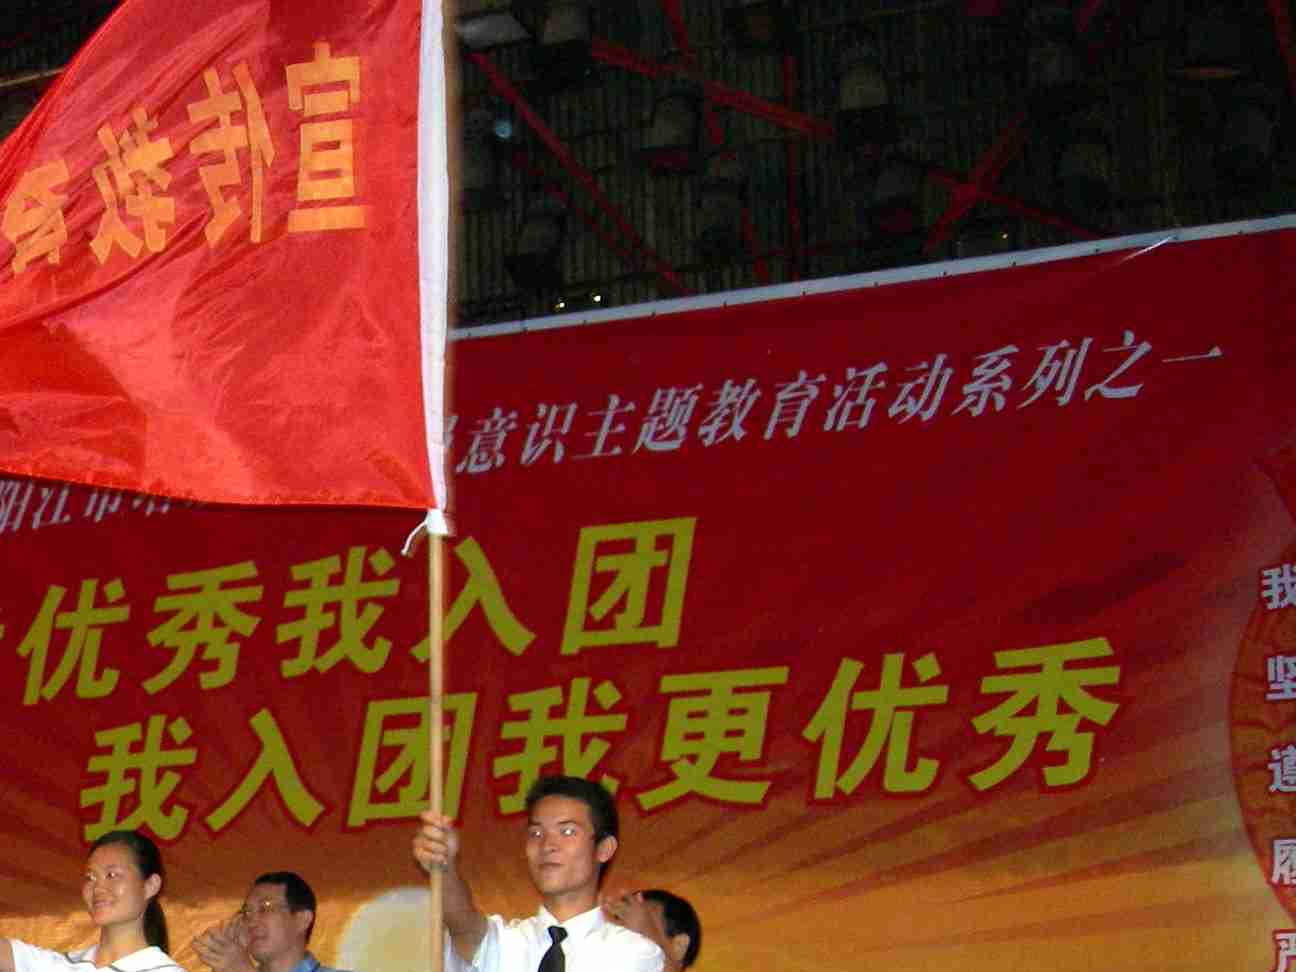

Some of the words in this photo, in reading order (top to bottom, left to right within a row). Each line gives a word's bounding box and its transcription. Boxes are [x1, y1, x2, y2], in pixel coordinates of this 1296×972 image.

[80, 636, 1121, 842] 我入团我更优秀
